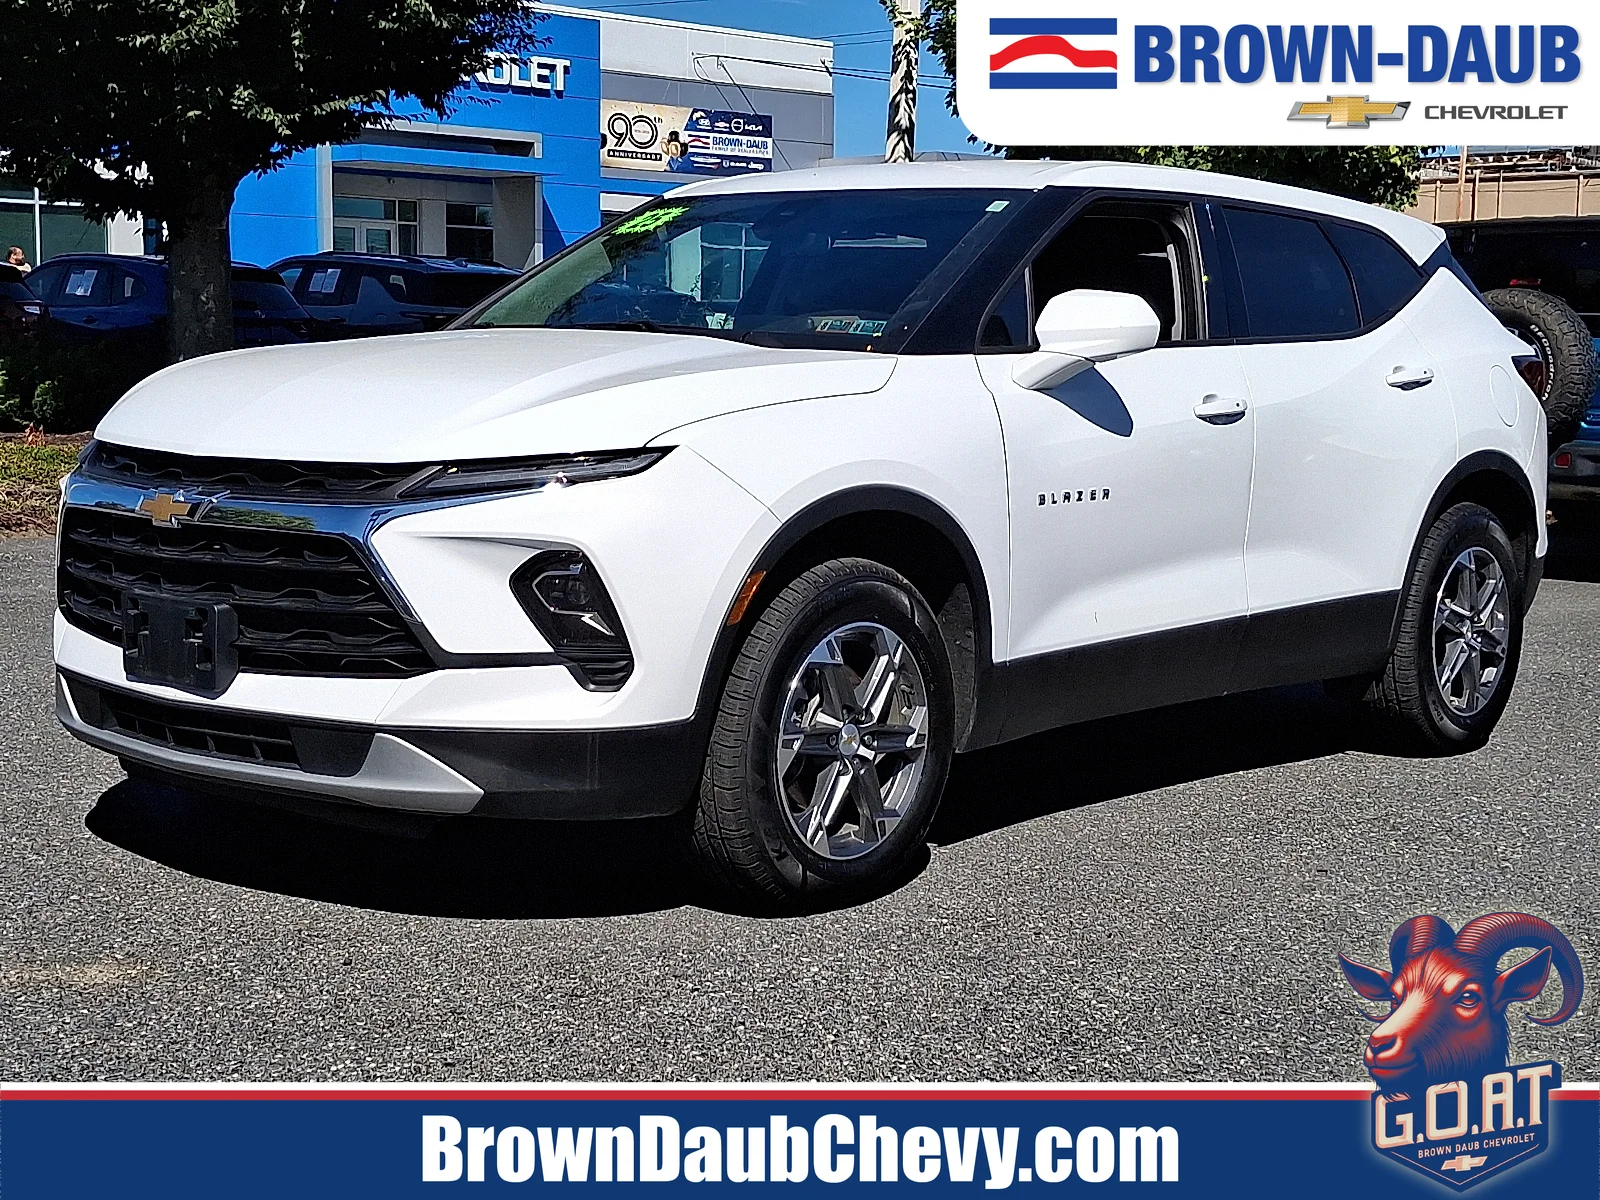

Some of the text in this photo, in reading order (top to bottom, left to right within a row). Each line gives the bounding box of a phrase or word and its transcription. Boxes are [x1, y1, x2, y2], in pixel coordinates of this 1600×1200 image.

[712, 136, 768, 150] BROWN-DAUB
[609, 150, 660, 160] ANNIVERSARY
[1037, 488, 1110, 506] BLAZER
